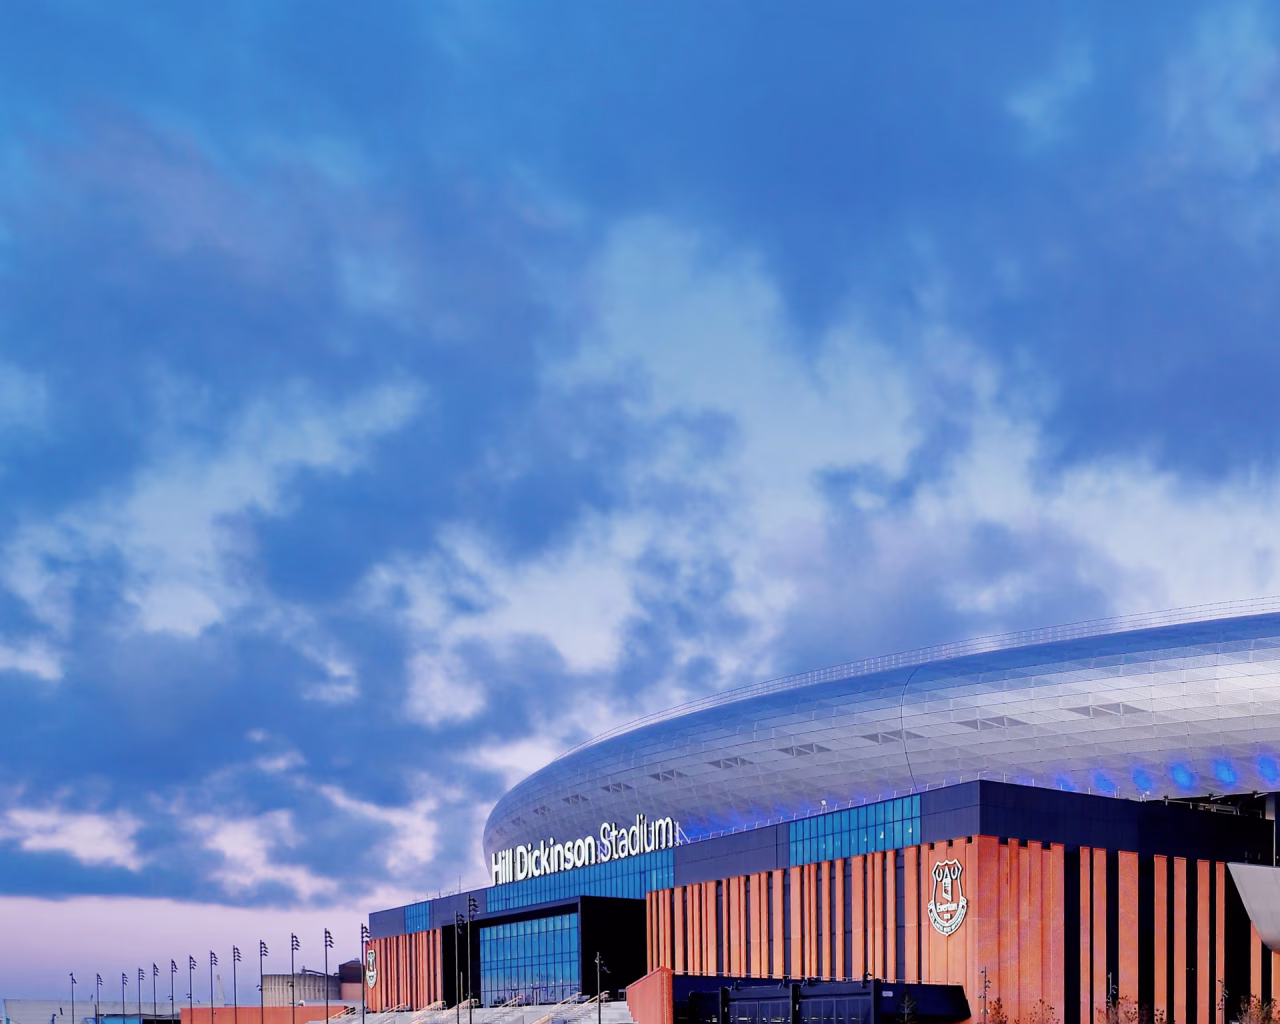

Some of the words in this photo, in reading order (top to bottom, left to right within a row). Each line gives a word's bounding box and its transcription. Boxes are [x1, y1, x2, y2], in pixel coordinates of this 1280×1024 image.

[491, 848, 514, 886] Hill
[516, 835, 596, 881] Dickinson
[600, 813, 674, 862] Stadium
